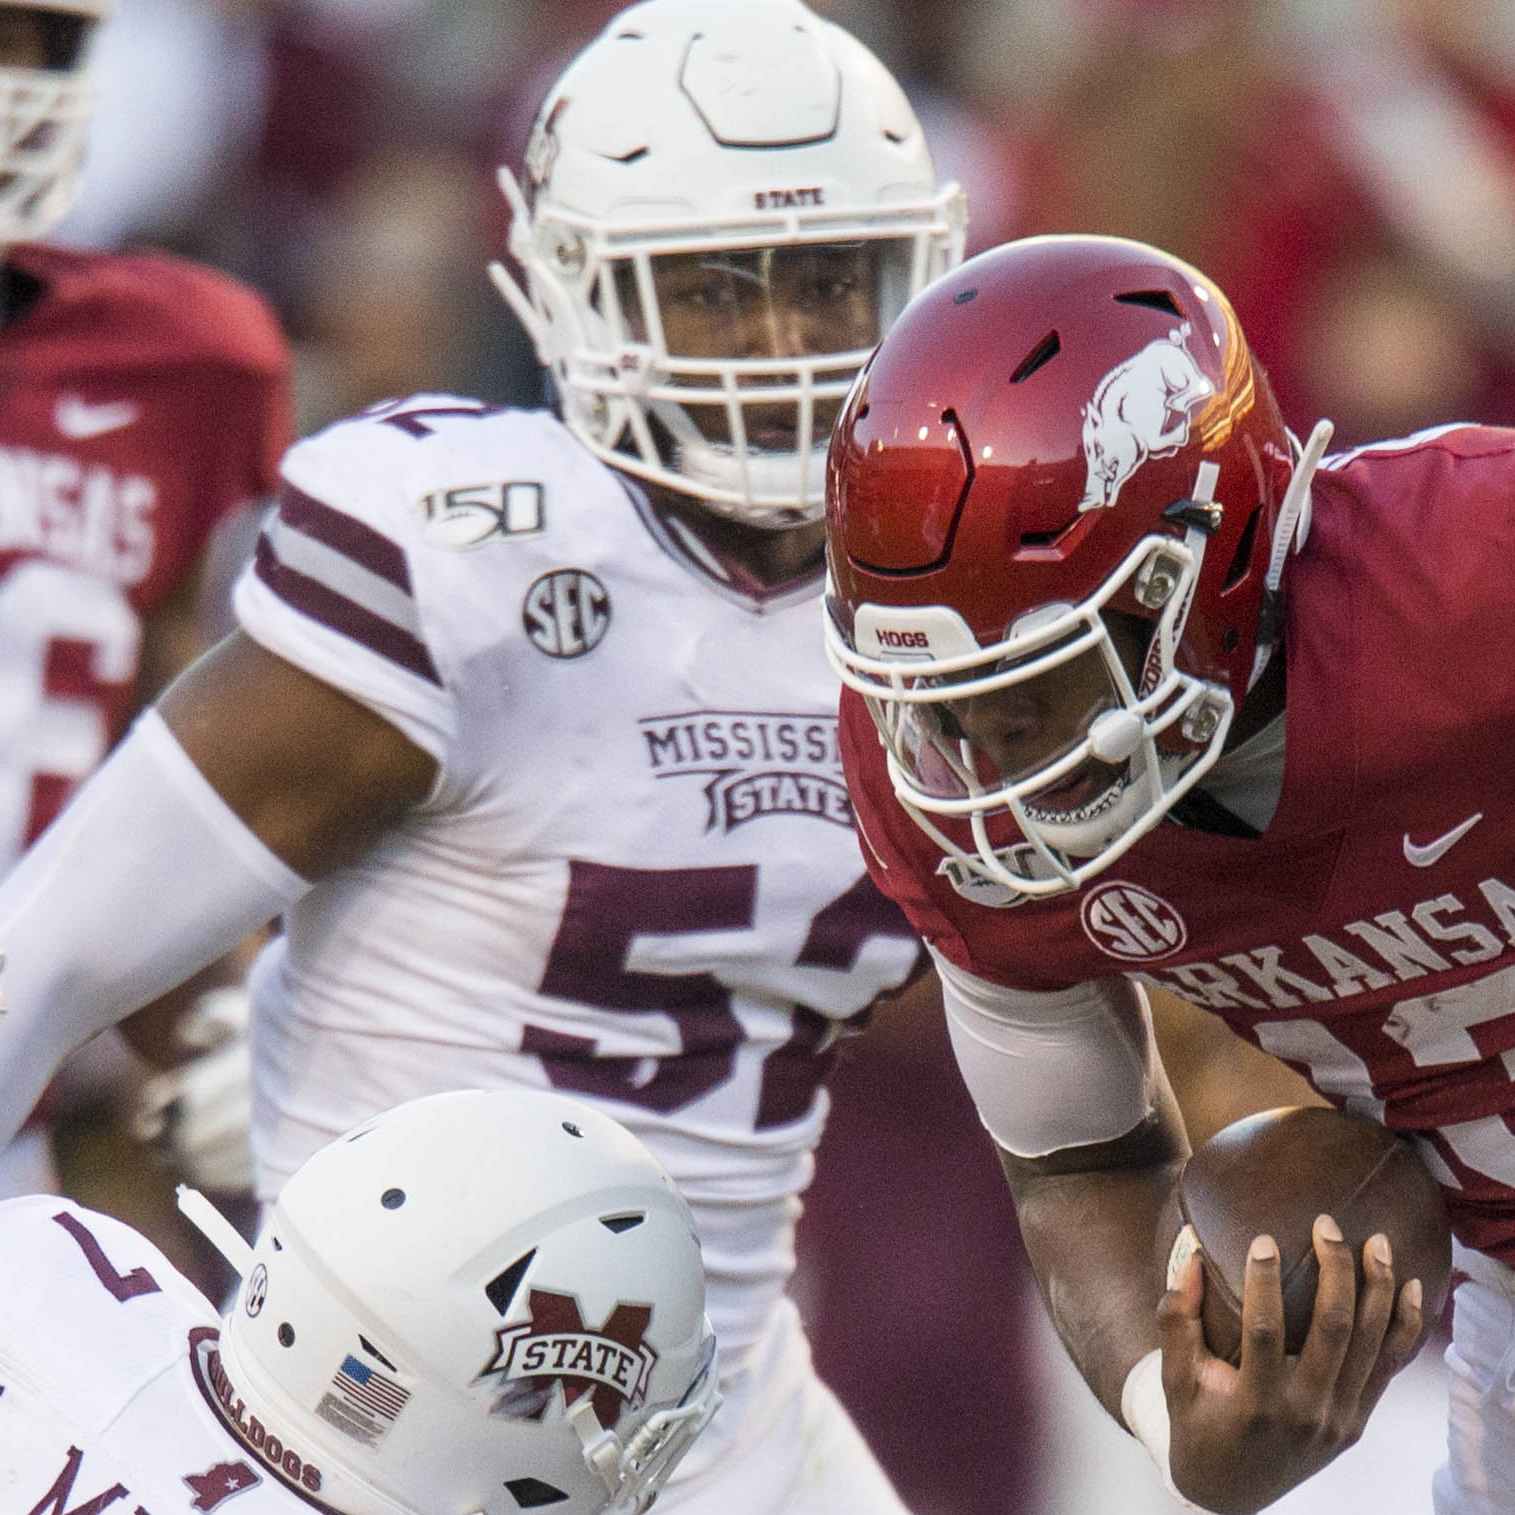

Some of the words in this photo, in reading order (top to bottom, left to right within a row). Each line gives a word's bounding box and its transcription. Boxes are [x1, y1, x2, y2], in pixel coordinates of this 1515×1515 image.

[525, 571, 609, 657] SEC
[875, 628, 929, 649] HOGS
[730, 774, 849, 823] STATE
[1088, 884, 1179, 956] SEC
[519, 858, 935, 1134] 52
[521, 1339, 636, 1388] STATE
